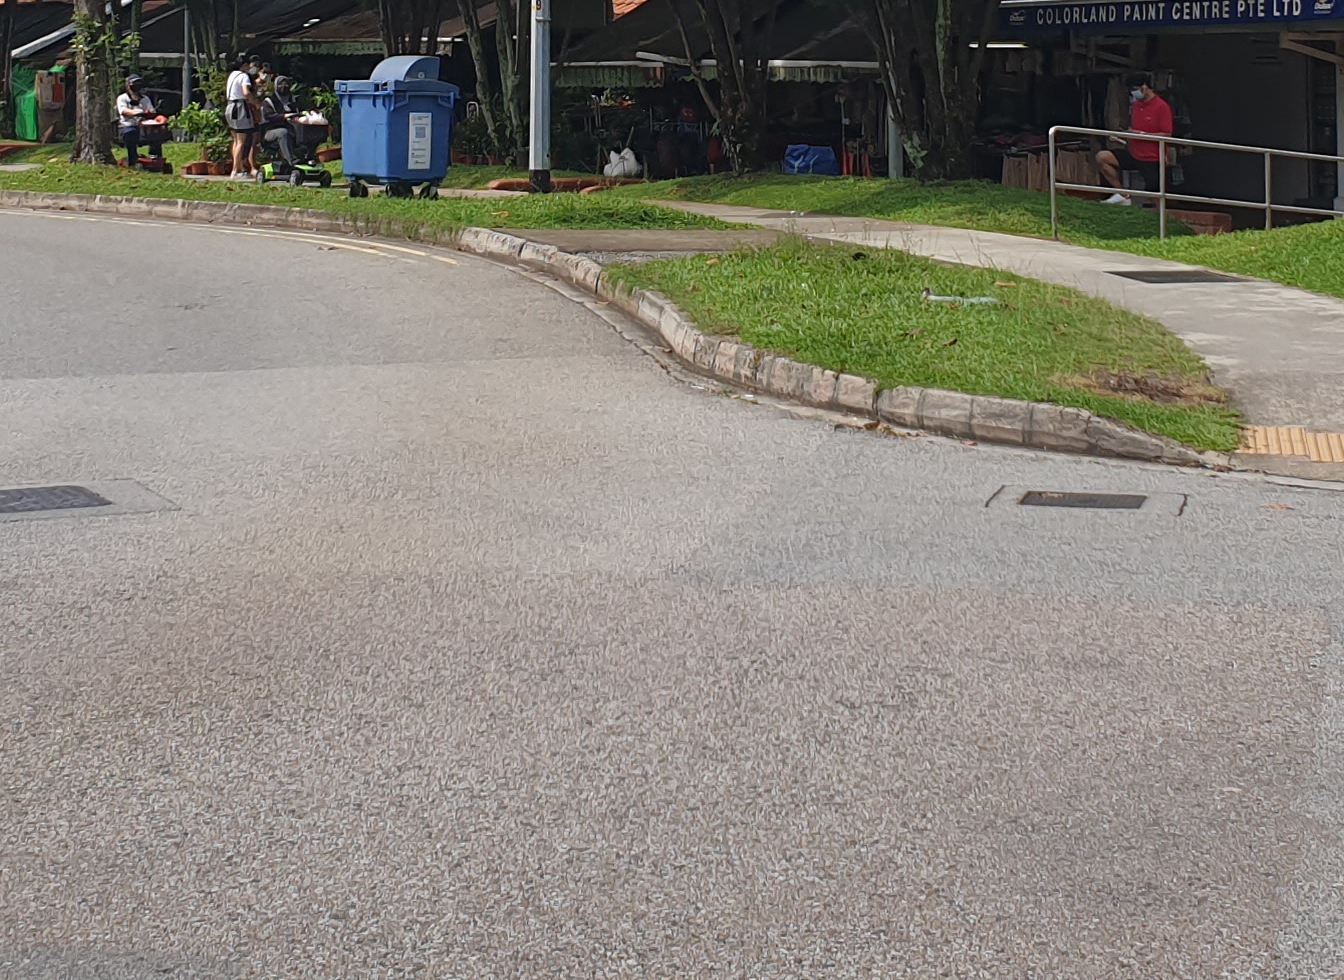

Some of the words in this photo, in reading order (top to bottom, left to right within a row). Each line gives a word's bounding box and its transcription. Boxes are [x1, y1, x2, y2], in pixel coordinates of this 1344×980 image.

[536, 0, 542, 10] 9
[1037, 5, 1116, 25] COLORLAND
[1124, 3, 1165, 21] PAINT
[1172, 0, 1230, 20] CENTRE
[1237, 0, 1265, 18] PTE
